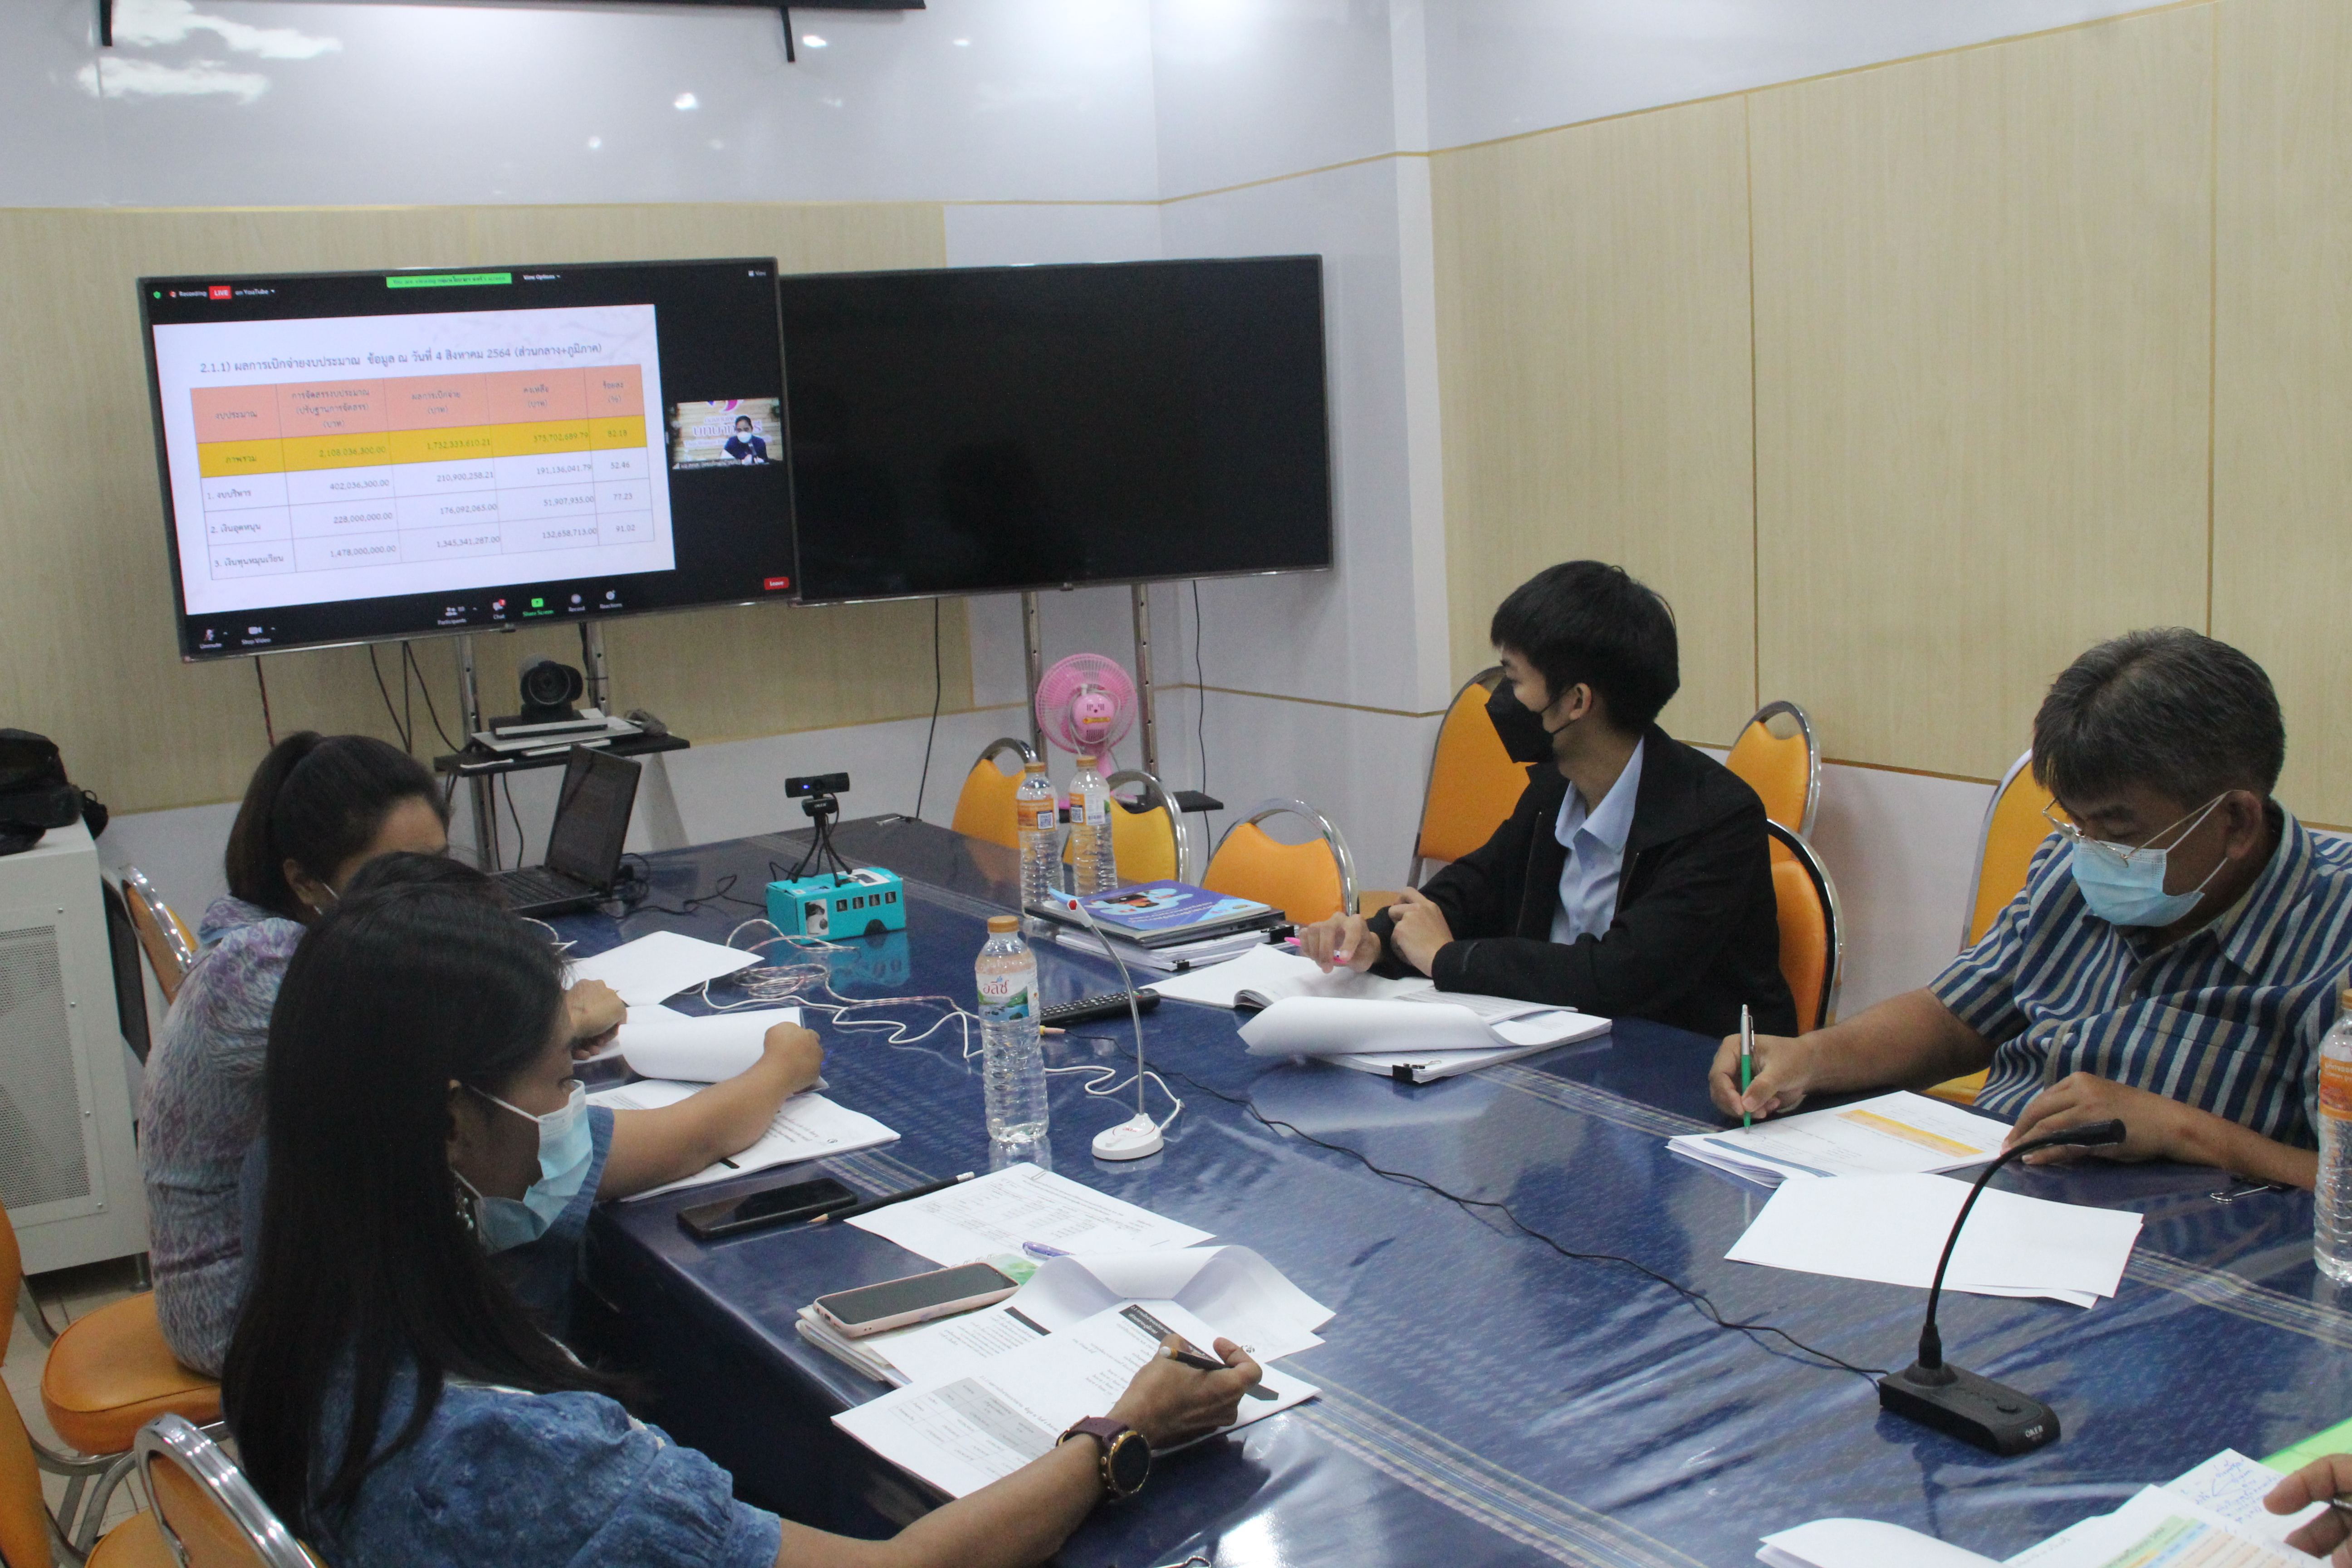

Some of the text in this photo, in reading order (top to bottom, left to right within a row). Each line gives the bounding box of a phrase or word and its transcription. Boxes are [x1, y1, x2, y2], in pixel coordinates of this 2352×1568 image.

[200, 342, 602, 373] 2.1.1) ผลการเบิกจ่ายงบประมาณ ข้อมูล ณ วันที่ 4 สิงหาคม 2564 (ส่วนกลาง+ภูมิภาค)
[523, 384, 549, 395] คงเหลือ
[603, 380, 624, 390] ร้อยละ
[292, 388, 369, 400] การจัดสรรงบประมาณ
[411, 390, 461, 401] ผลการเบิกจ่าย
[608, 395, 622, 403] (%)
[296, 402, 369, 416] (ปรับฐานการจัดสรร)
[427, 405, 448, 414] (บาท)
[528, 399, 548, 408] (บาท)
[215, 409, 258, 420] งบประมาณ
[323, 419, 345, 428] (บาท)
[533, 431, 589, 443] 375,702,689.79
[608, 429, 628, 438] 82.18
[426, 438, 491, 451] 1,732,333,610.21
[318, 446, 386, 458] 2,108,036,300.00
[225, 454, 257, 464] ภาพรวม
[536, 463, 592, 475] 191,136,041.79
[610, 461, 631, 470] 52.46
[436, 470, 494, 482] 210,900,258.21
[330, 479, 390, 491] 402,036,300.00
[217, 488, 252, 499] งบบริหาร
[613, 492, 633, 501] 77.23
[543, 495, 595, 507] 51,907,935.00
[440, 503, 498, 515] 176,092,065.00
[333, 512, 393, 524] 228,000,000.00
[220, 522, 261, 535] เงินอุดหนุน
[542, 527, 598, 539] 132,658,713.00
[615, 524, 636, 533] 91.02
[436, 535, 500, 549] 1,345,341,287.00
[329, 544, 397, 558] 1,478,000,000.00
[225, 553, 284, 568] เงินทุนหมุนเวียน
